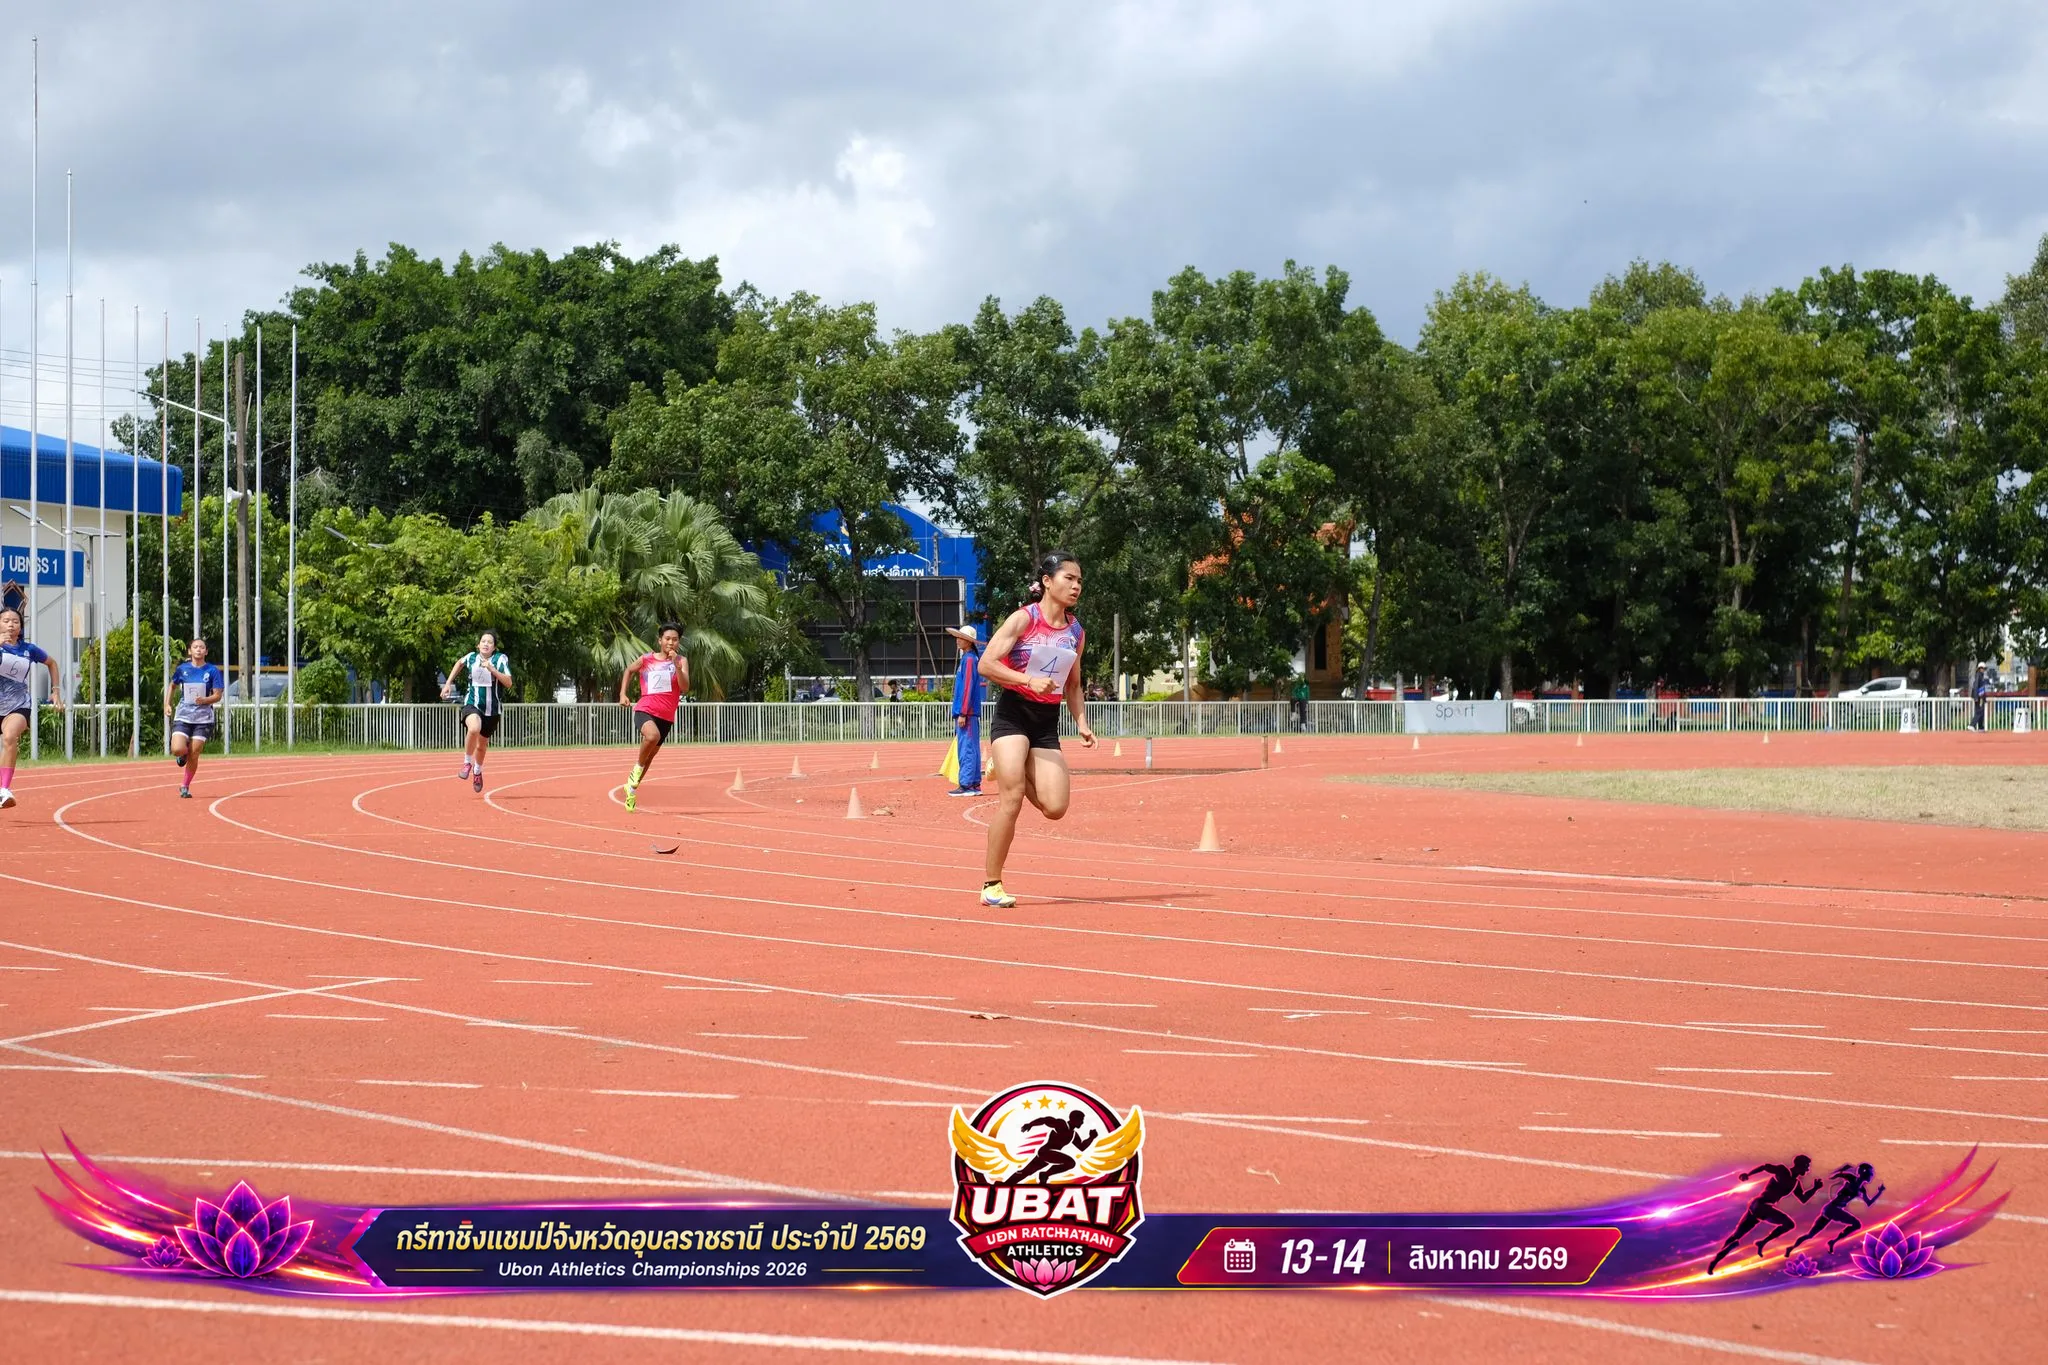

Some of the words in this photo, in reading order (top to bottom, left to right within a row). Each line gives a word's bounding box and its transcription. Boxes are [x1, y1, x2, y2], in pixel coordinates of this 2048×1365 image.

[52, 558, 58, 575] 1
[1040, 656, 1059, 678] 4
[652, 674, 663, 690] 2
